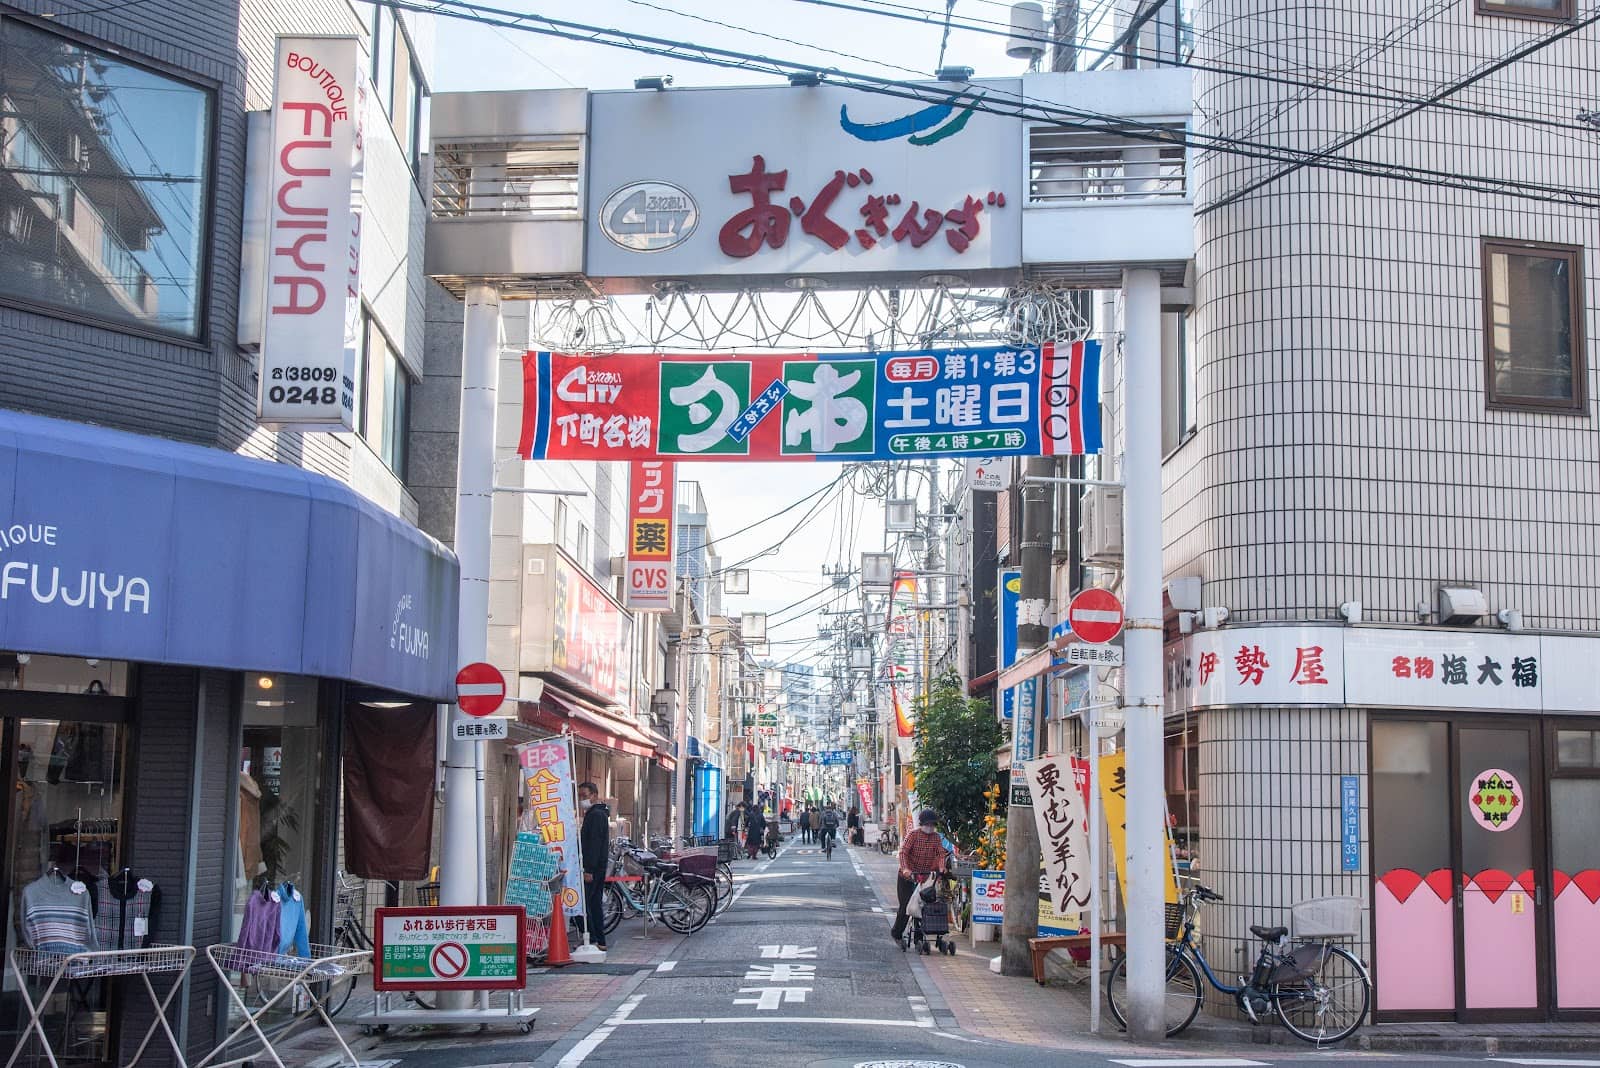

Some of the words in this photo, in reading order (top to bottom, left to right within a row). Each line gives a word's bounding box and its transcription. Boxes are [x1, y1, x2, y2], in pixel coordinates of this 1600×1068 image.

[287, 52, 348, 122] BOUTIQUE
[272, 101, 332, 315] FUJIYA
[719, 154, 1006, 259] おぐぎんざ
[269, 386, 337, 405] 0248
[734, 387, 780, 436] ふれあい
[884, 382, 1030, 428] 土曜日
[556, 412, 652, 448] 下町名物
[0, 523, 57, 553] IQUE
[635, 522, 666, 553] 薬
[1, 561, 150, 614] FUJIYA
[632, 568, 668, 589] CVS
[398, 624, 428, 660] FUJIYA
[1070, 648, 1120, 664] 自転車を除く
[1198, 645, 1328, 686] 伊勢屋
[456, 722, 503, 737] 自転車を除く
[1035, 763, 1092, 914] 栗むし羊かん
[403, 918, 497, 931] ふれあい歩行者天国
